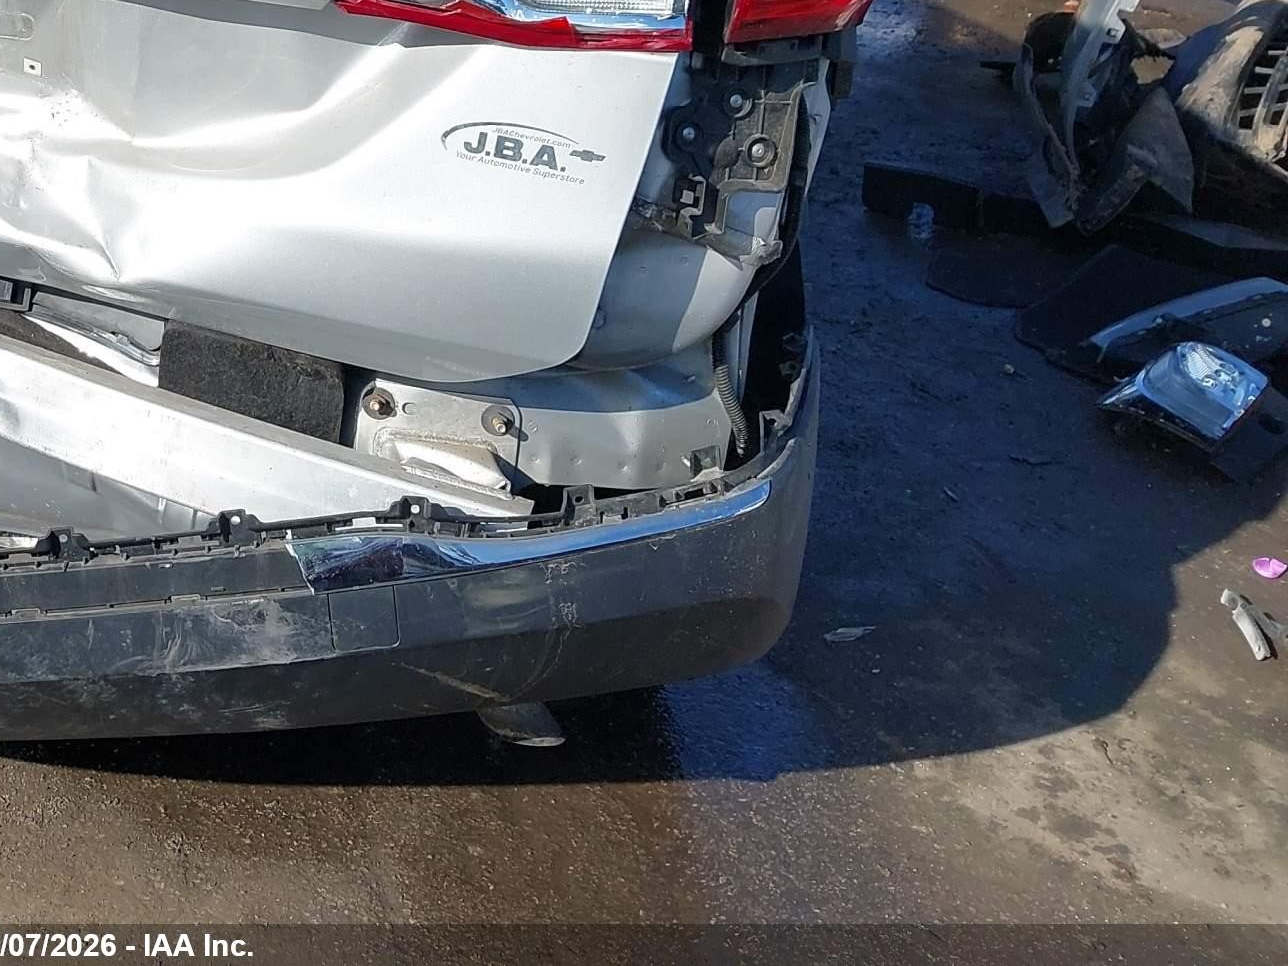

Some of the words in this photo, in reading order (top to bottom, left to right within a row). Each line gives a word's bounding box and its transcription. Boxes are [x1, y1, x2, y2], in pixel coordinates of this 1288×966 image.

[455, 151, 476, 163] Your
[478, 155, 531, 174] Automotive
[532, 168, 585, 186] Superstore
[463, 131, 566, 172] J.B.A.
